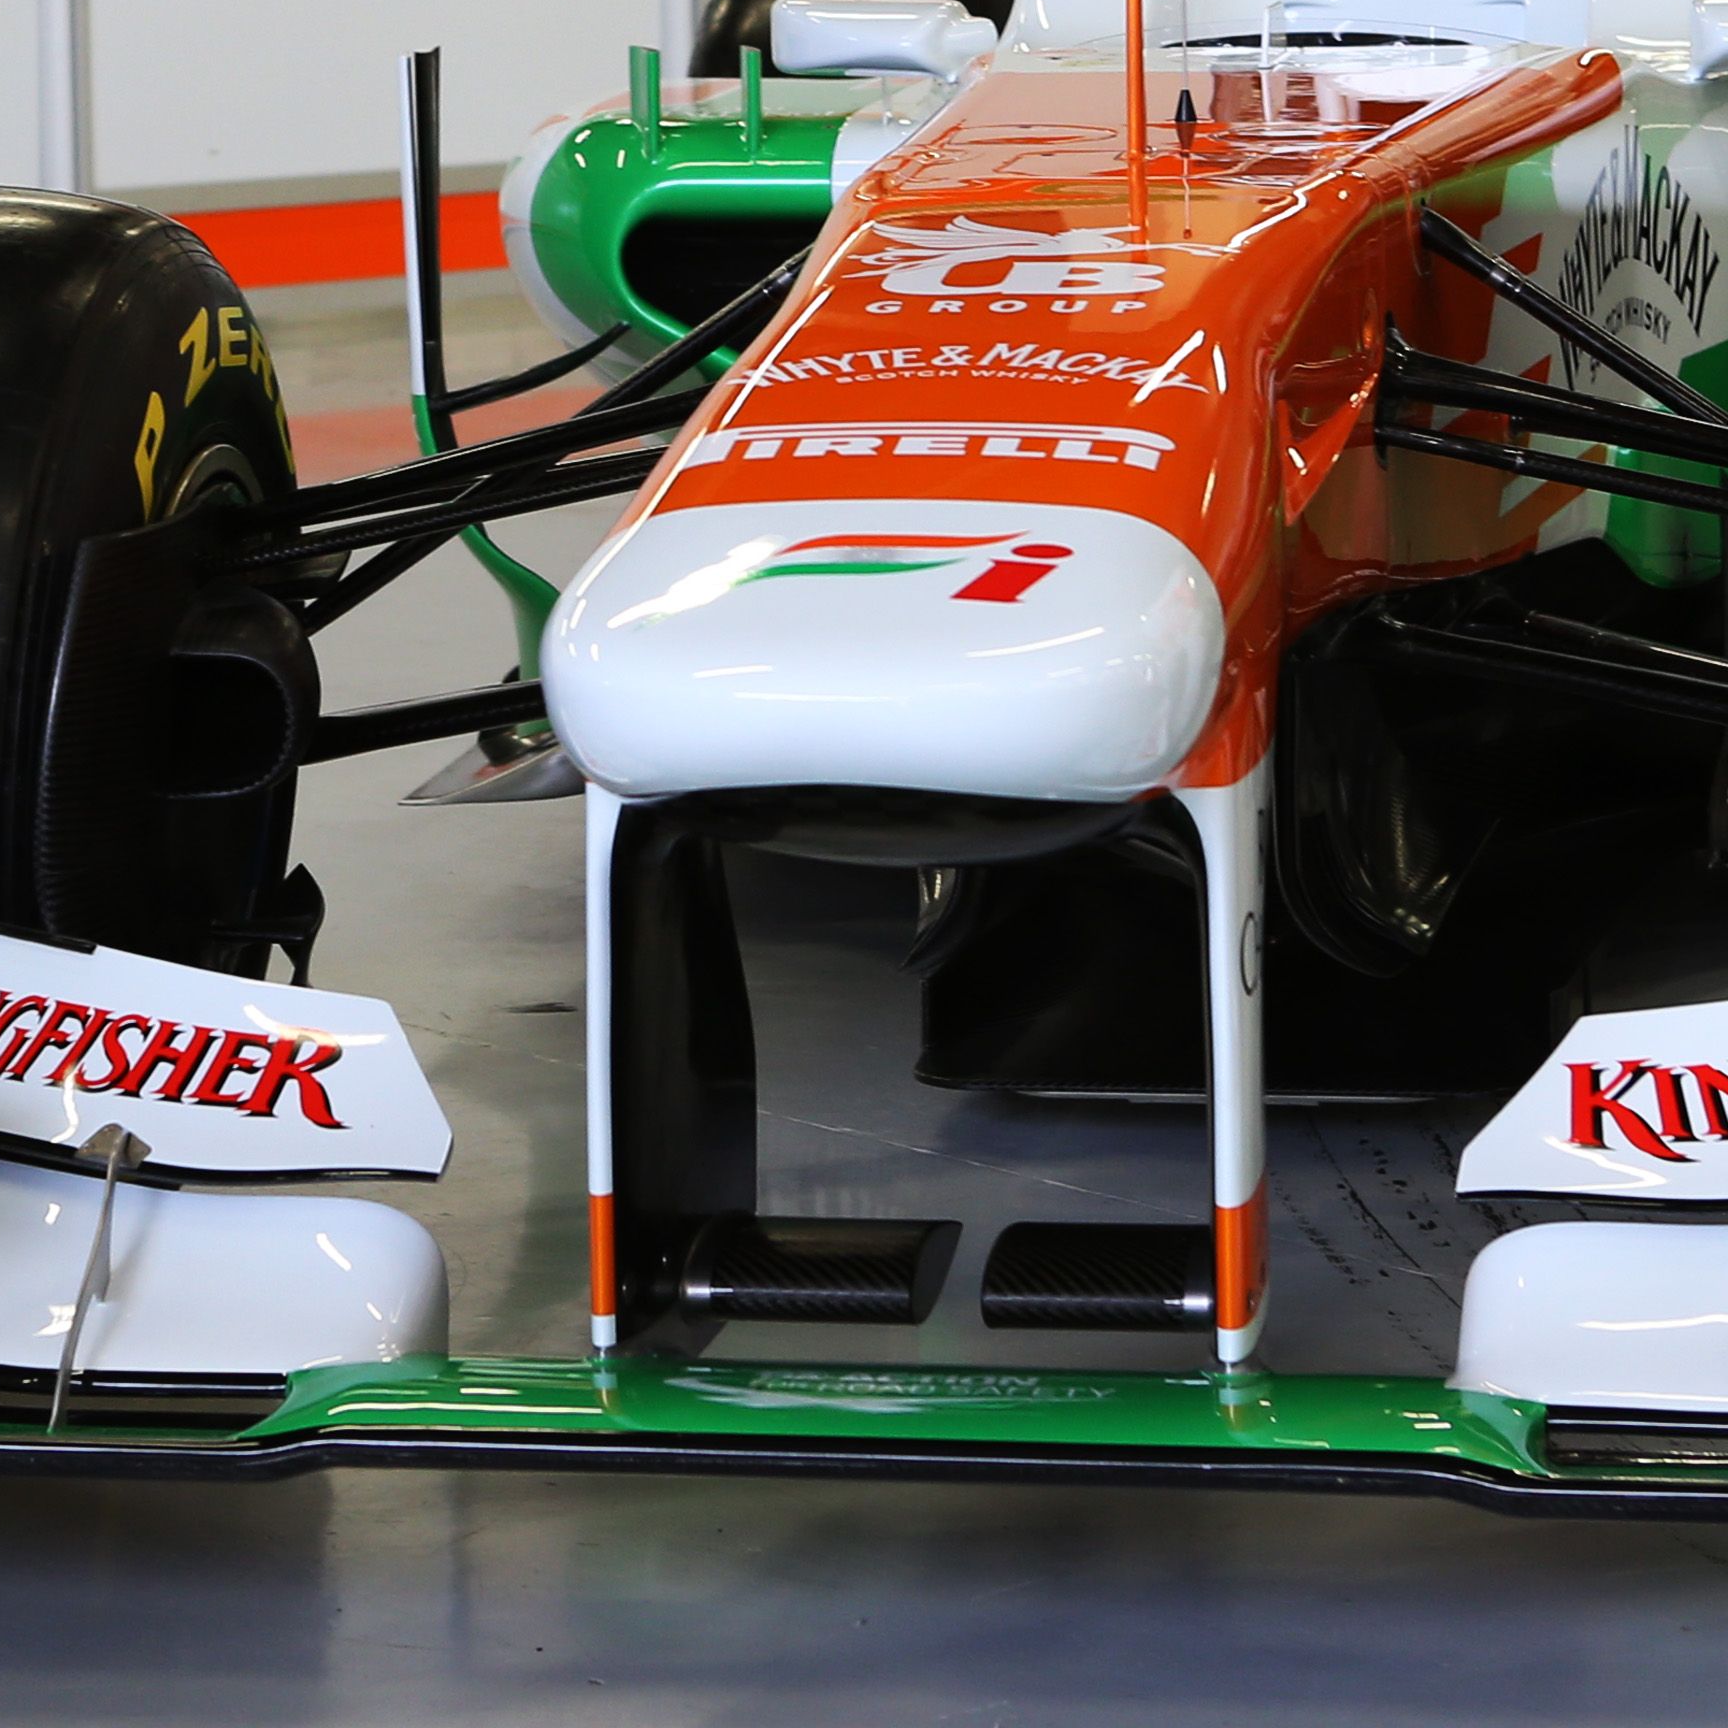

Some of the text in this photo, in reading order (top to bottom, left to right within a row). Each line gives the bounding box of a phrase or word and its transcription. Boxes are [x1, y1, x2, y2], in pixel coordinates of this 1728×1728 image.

[881, 258, 1167, 296] UB
[865, 299, 1149, 316] GROUP
[728, 342, 1210, 394] WHYTE & MACKAY
[835, 368, 1091, 385] SCOTCH WHISKY
[678, 422, 1175, 472] PIRELLI
